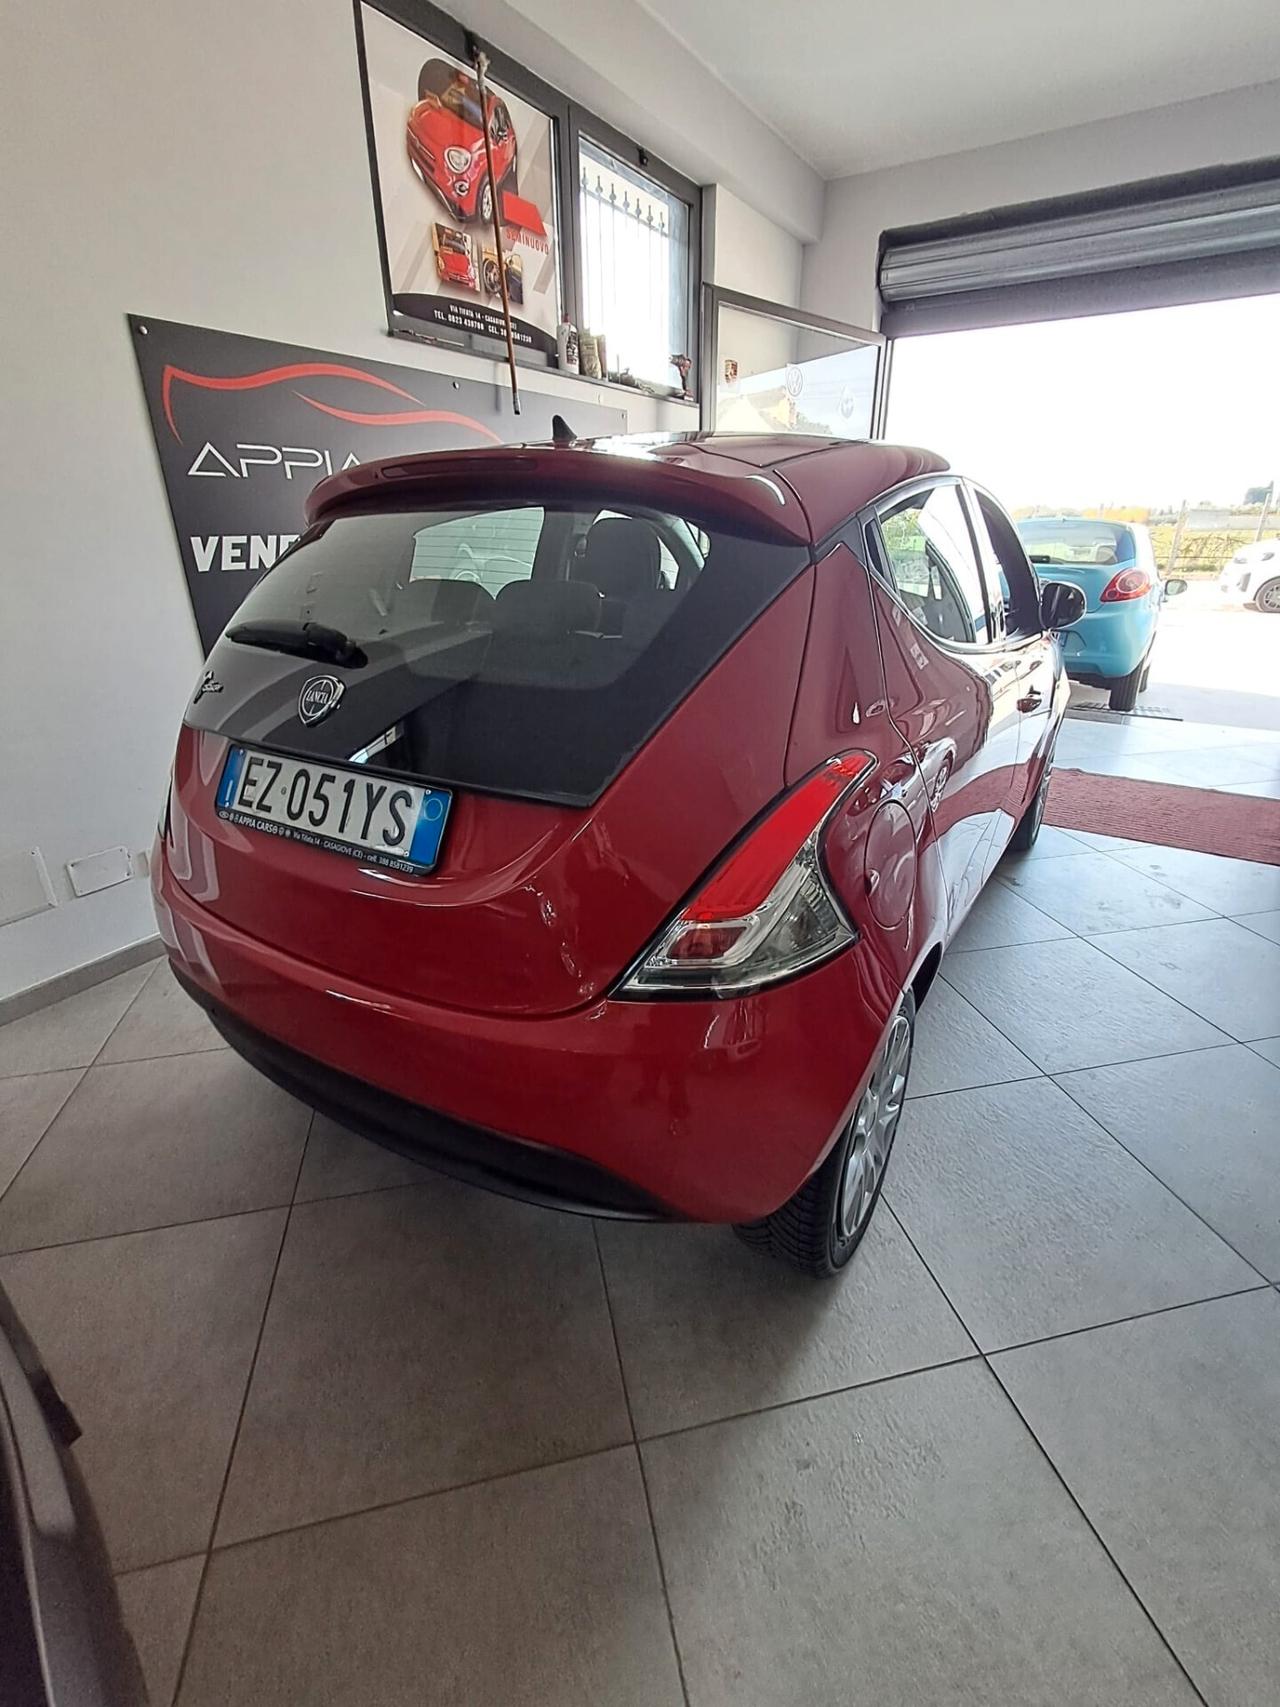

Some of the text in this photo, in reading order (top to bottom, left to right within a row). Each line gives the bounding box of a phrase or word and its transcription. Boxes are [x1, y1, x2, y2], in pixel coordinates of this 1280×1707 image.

[449, 304, 459, 313] VIA
[433, 309, 447, 321] TEL.
[488, 324, 500, 335] CEL.
[305, 690, 329, 704] LANCIA
[237, 756, 413, 847] EZ 051YS
[238, 815, 256, 829] APPIA
[256, 820, 273, 833] CARS
